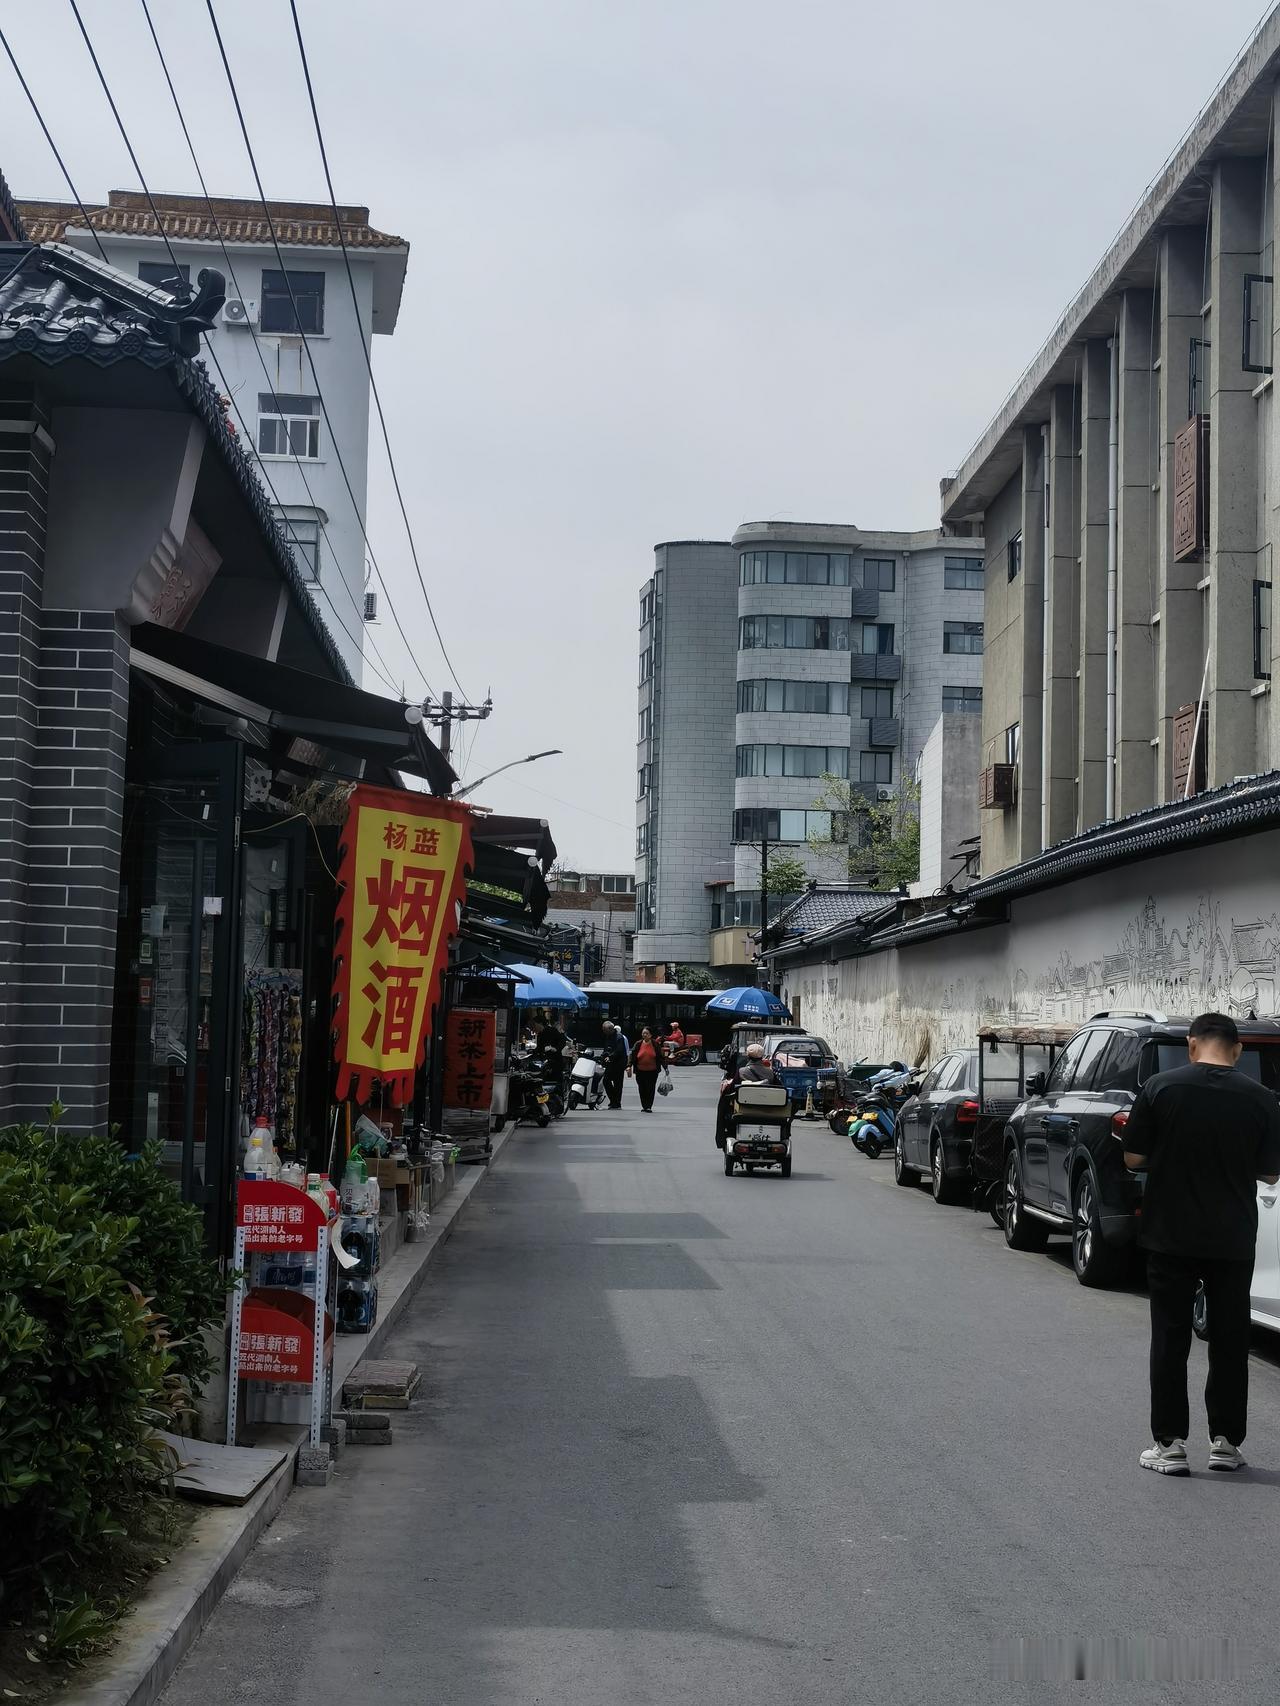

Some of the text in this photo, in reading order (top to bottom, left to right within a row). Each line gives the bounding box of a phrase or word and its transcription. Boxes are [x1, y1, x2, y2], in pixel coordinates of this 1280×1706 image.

[383, 821, 442, 857] 杨蓝
[361, 857, 447, 1056] 烟酒
[457, 1018, 487, 1106] 新茶上市
